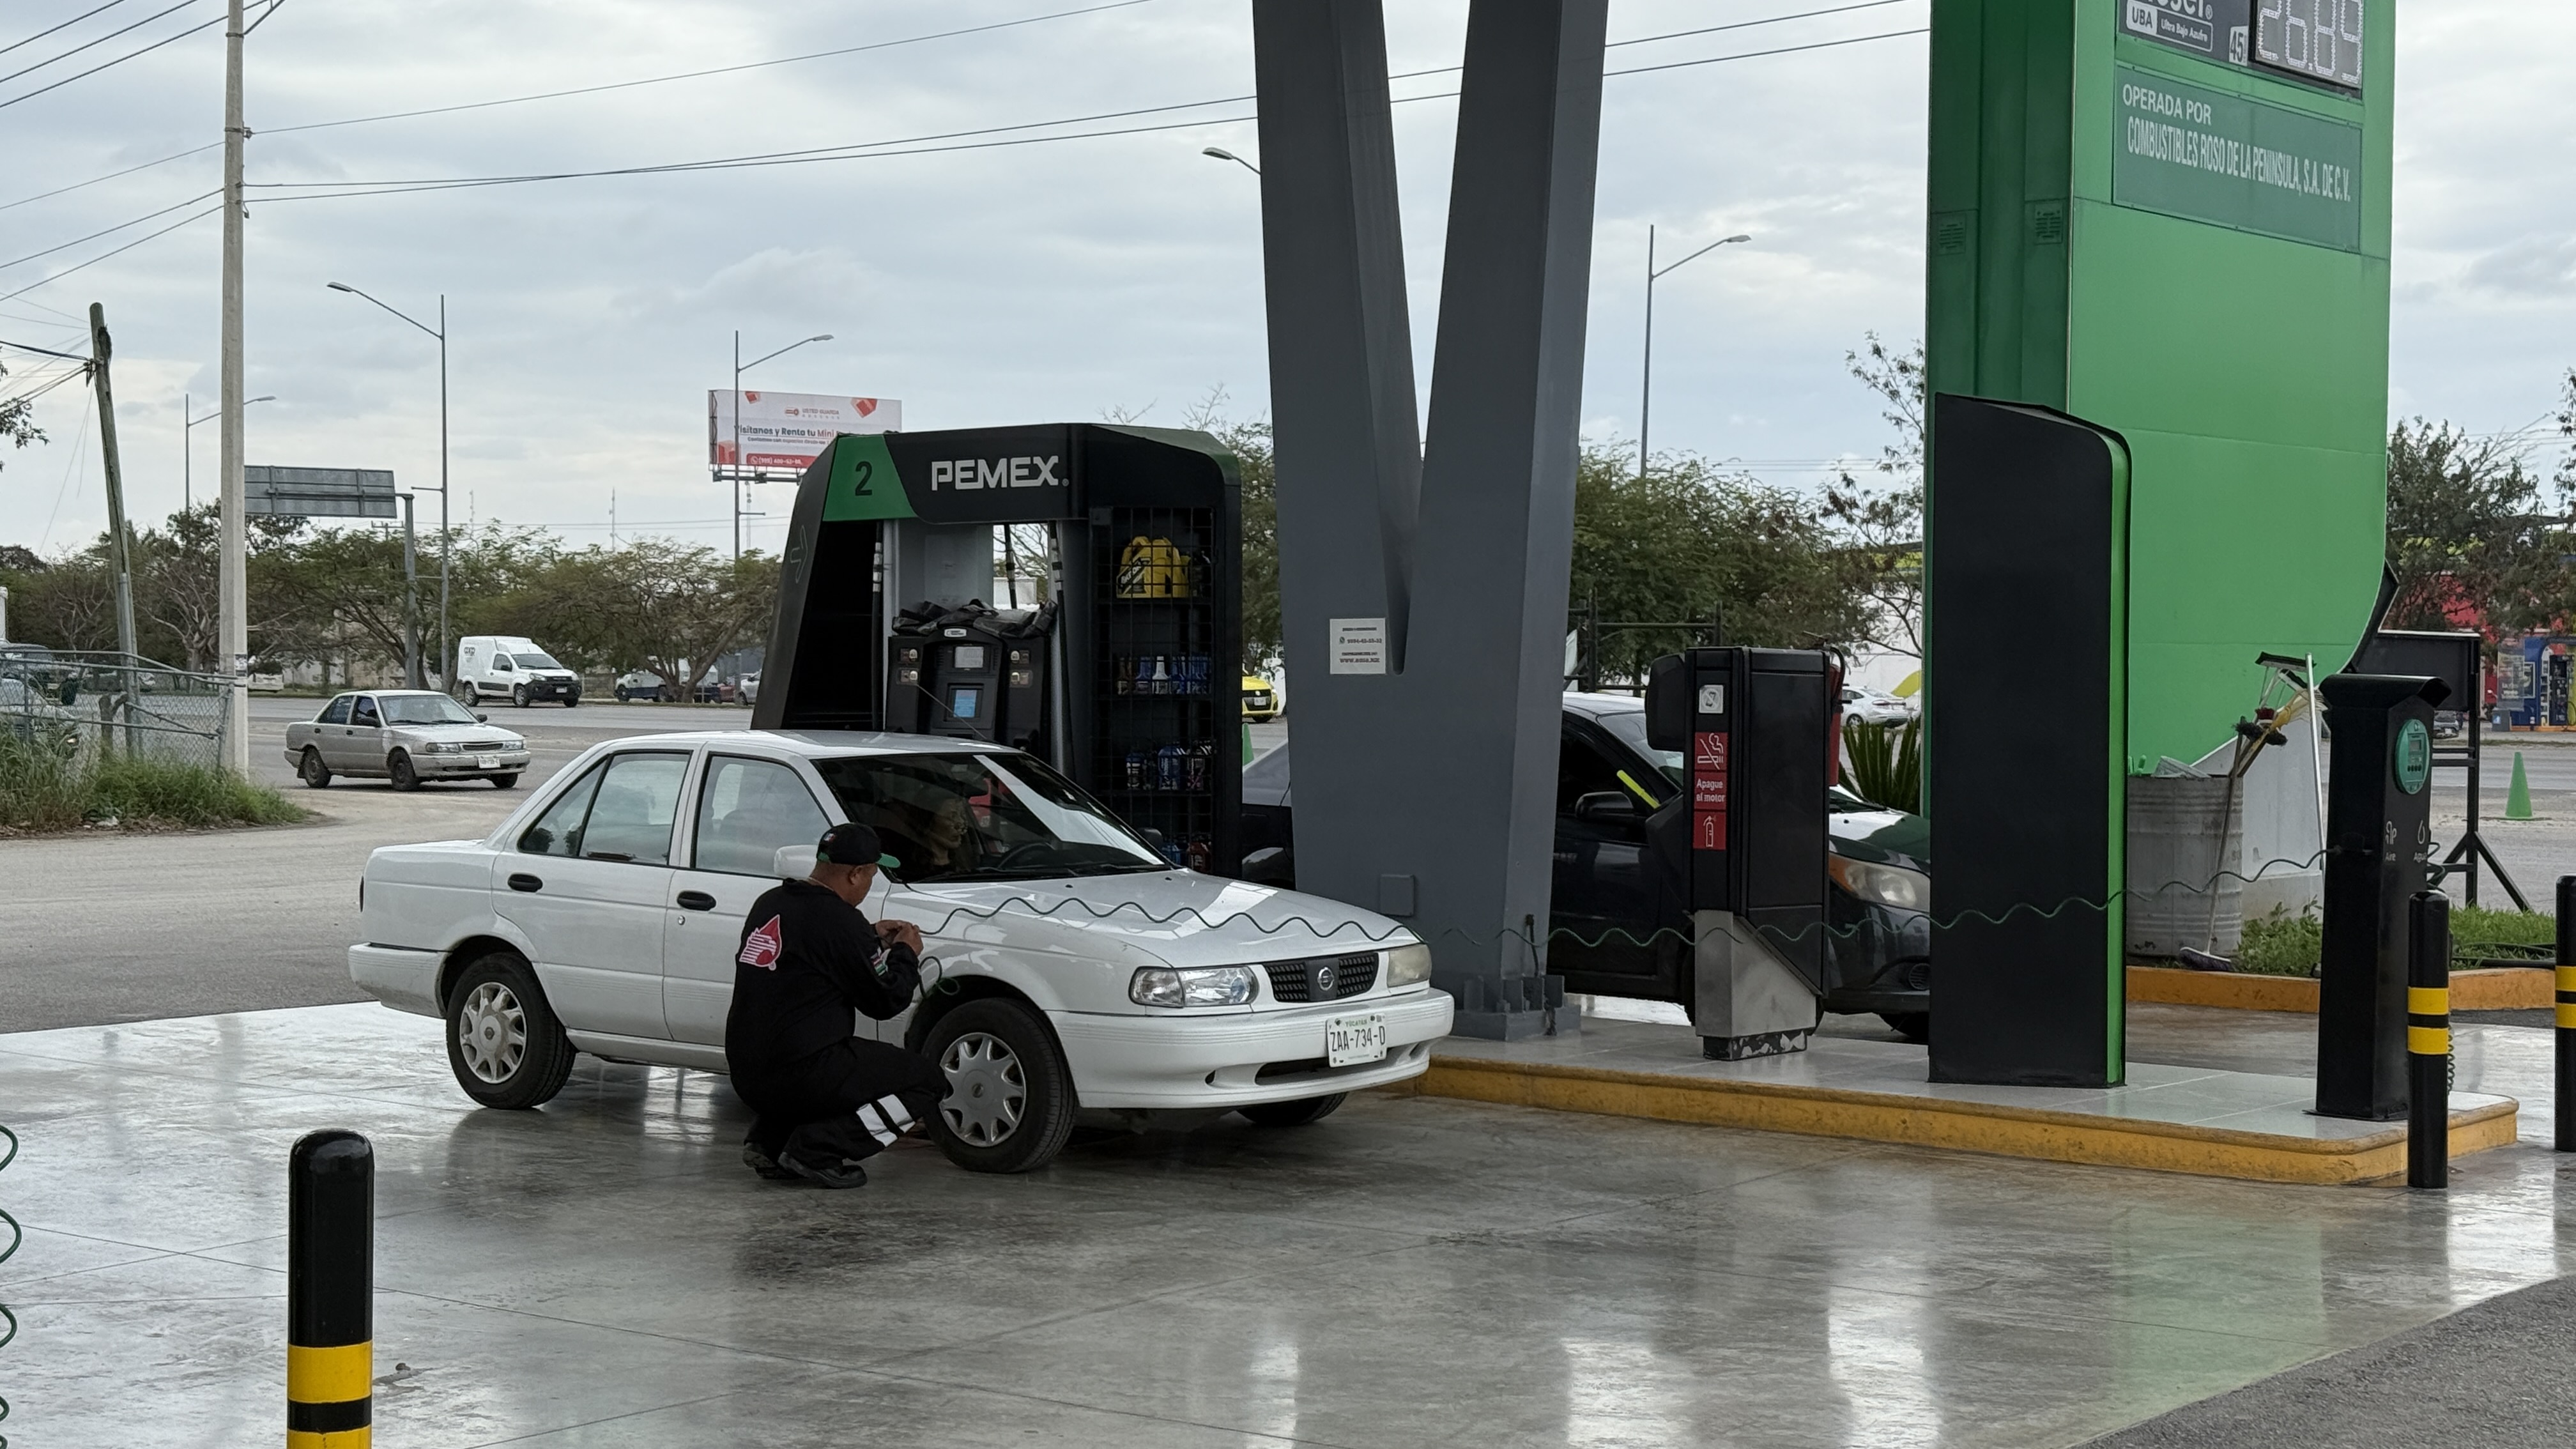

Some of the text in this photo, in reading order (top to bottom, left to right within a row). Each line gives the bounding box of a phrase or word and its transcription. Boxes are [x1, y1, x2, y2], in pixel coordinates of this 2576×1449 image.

[2132, 6, 2153, 29] UBA
[2161, 18, 2175, 33] Ultra
[2230, 30, 2244, 63] 45
[2122, 84, 2212, 126] OPERADA POR
[2128, 116, 2198, 168] COMBUSTIBLES
[2200, 134, 2225, 173] ROSO
[2227, 140, 2239, 176] DE
[2240, 143, 2252, 180] LA
[2253, 146, 2302, 197] PENINSULA,
[2303, 158, 2320, 195] S.A.
[2322, 163, 2333, 198] DE
[775, 428, 780, 437] y
[781, 427, 806, 436] Renta
[817, 429, 834, 438] Mini
[855, 461, 873, 496] 2
[931, 456, 1059, 491] PEMEX
[1696, 778, 1723, 791] Apague
[1696, 792, 1726, 802] el motor
[1330, 1025, 1385, 1052] ZAA-734-D
